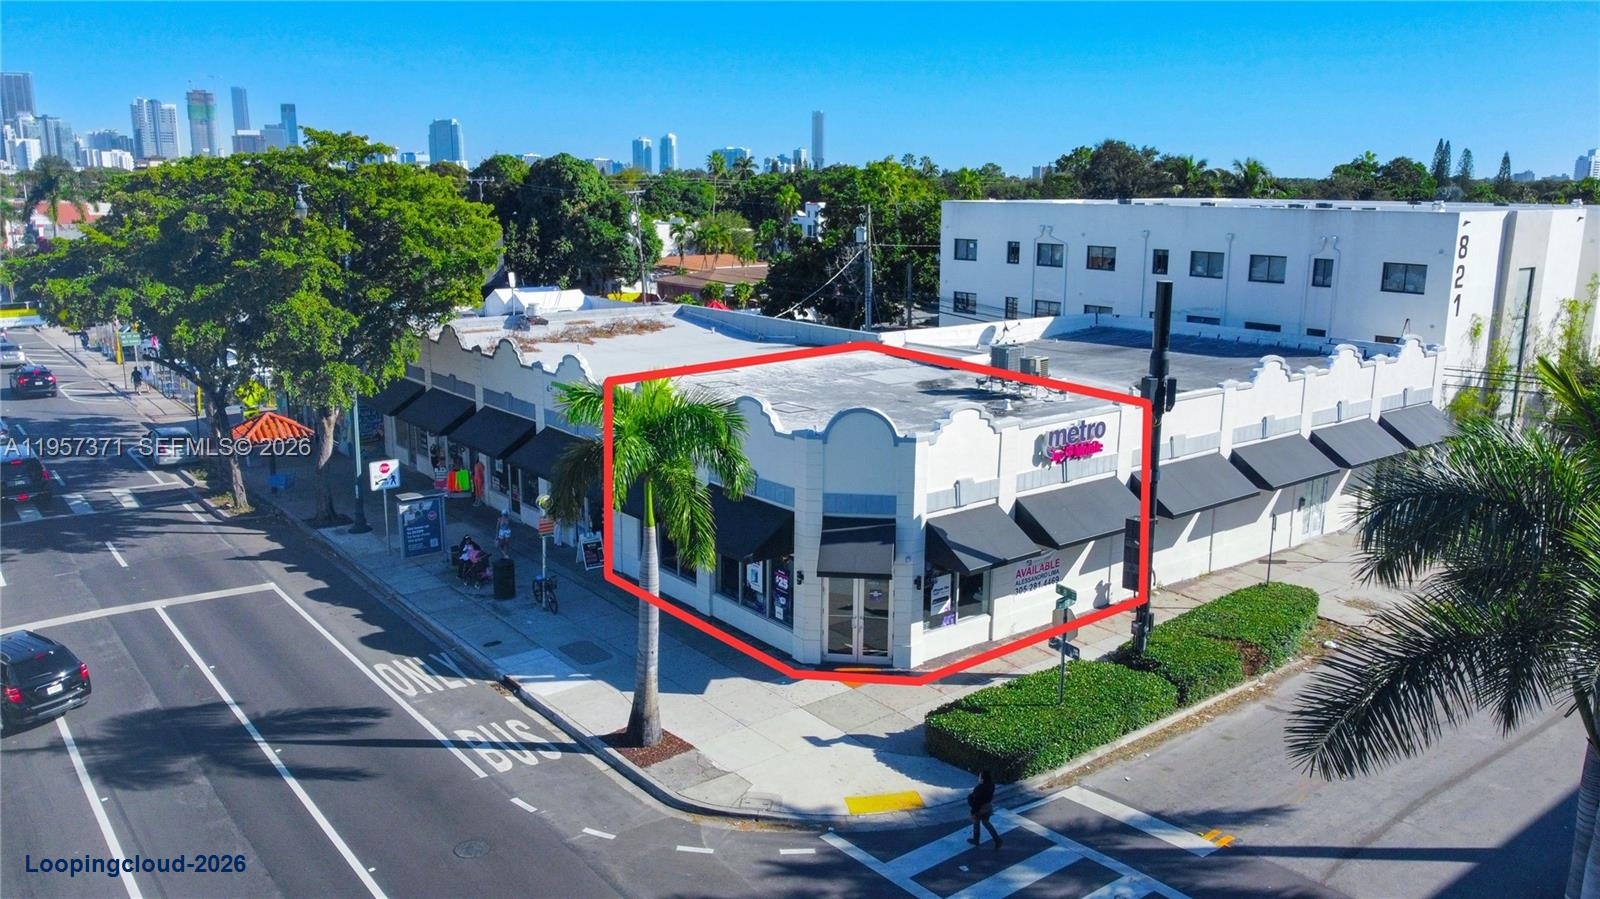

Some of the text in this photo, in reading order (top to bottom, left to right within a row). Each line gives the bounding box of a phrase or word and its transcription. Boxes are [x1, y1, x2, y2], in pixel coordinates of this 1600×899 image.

[1453, 235, 1469, 317] 821
[1048, 420, 1106, 447] metro
[1015, 558, 1061, 579] AVAILABLE
[1015, 571, 1048, 586] ALESSANDRO
[373, 652, 477, 697] ONLY
[454, 719, 562, 773] BUS
